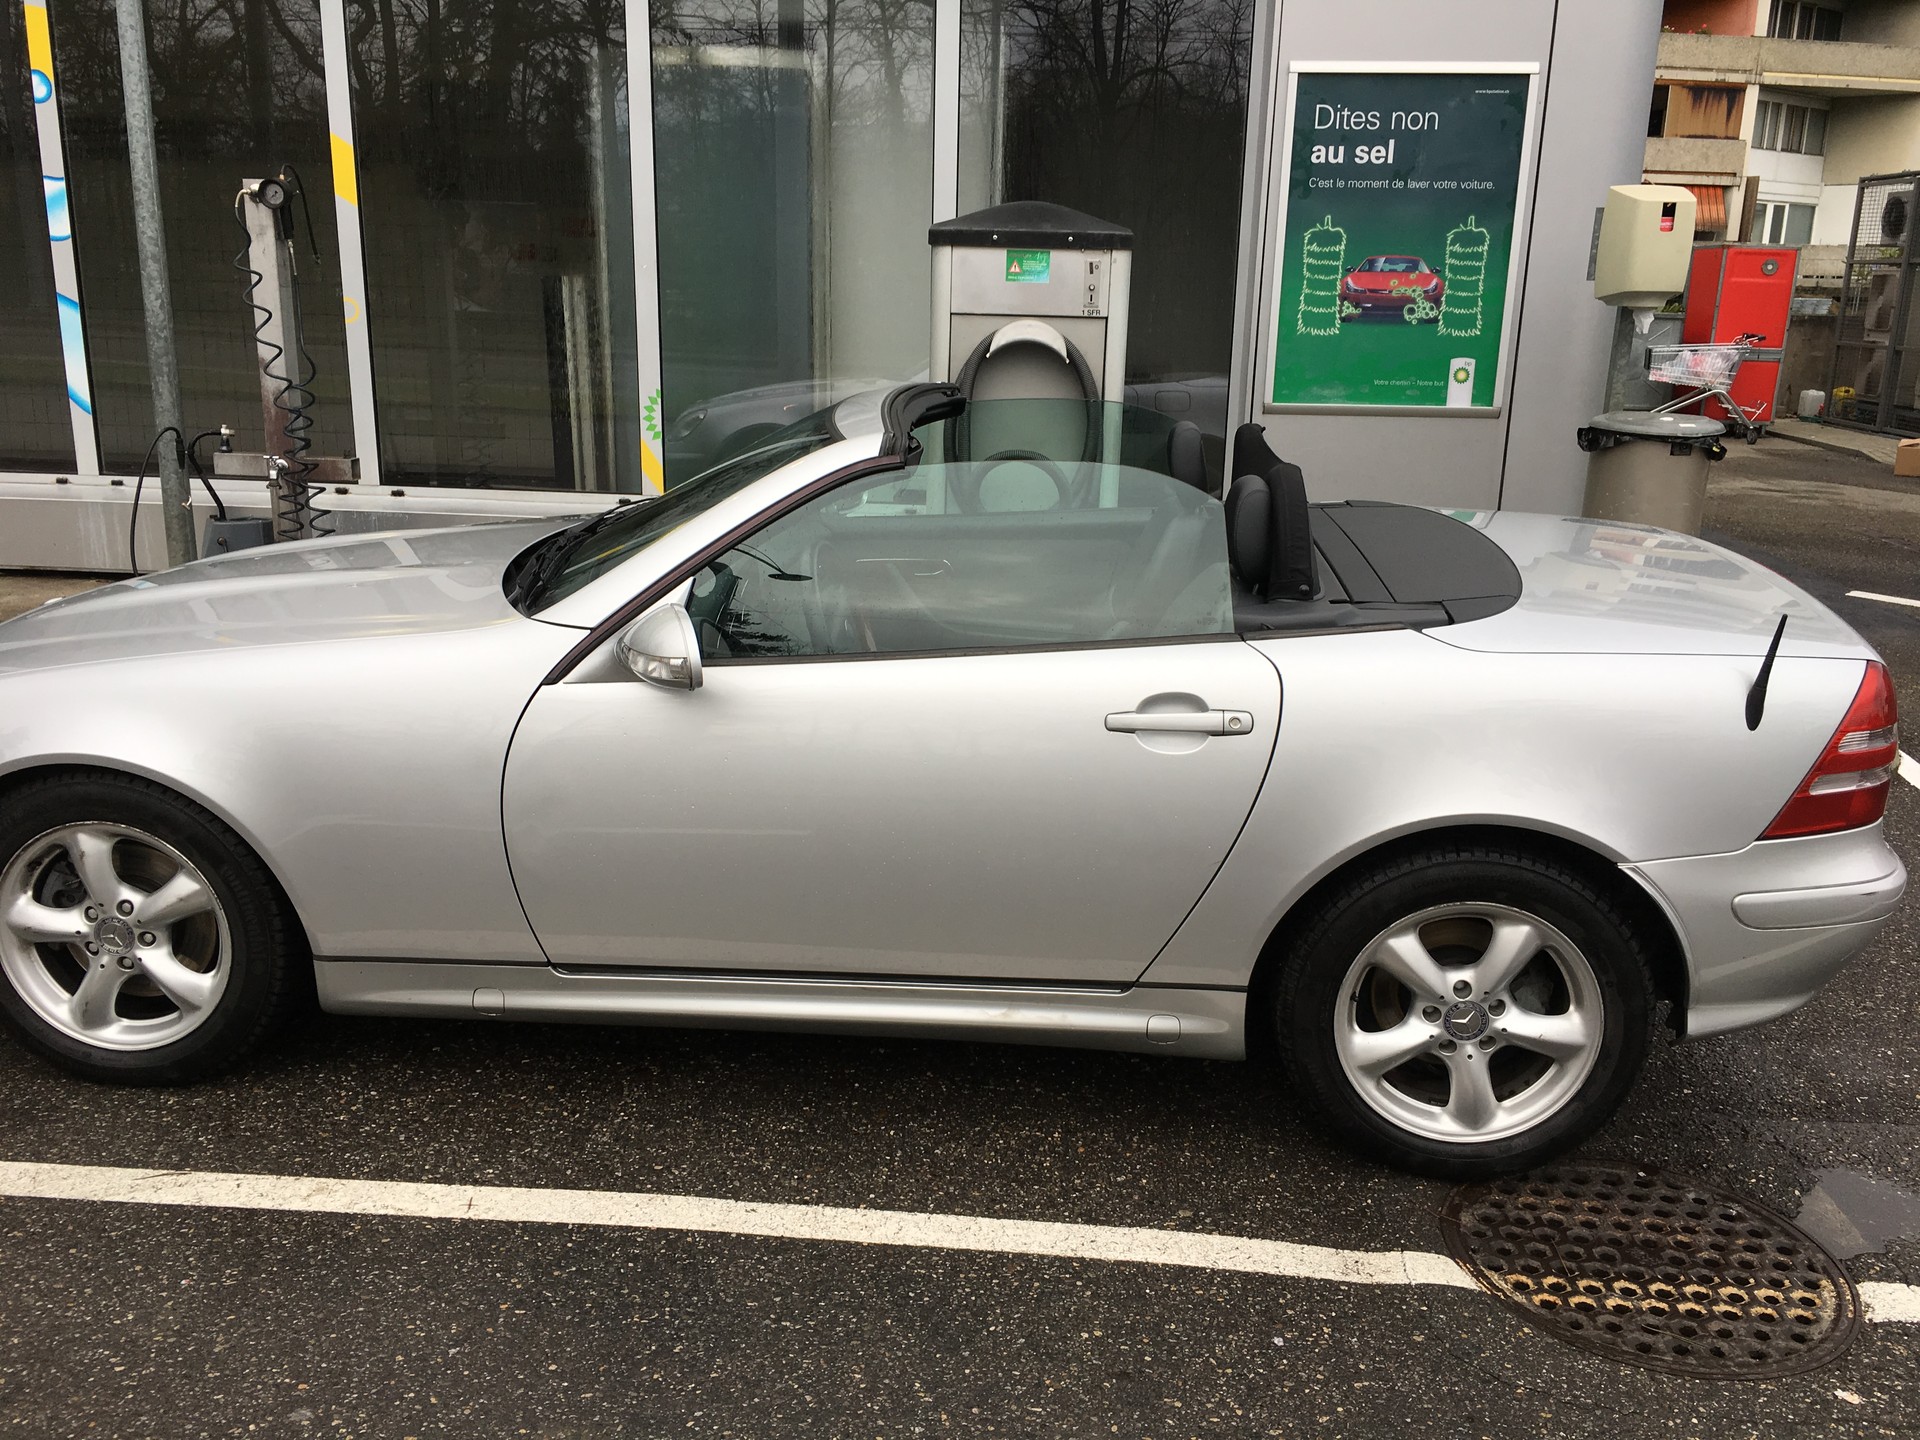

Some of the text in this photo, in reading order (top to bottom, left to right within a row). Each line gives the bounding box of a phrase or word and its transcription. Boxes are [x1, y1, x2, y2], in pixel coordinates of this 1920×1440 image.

[1314, 104, 1439, 130] Dites non
[1310, 139, 1395, 164] au sel
[1308, 177, 1495, 189] C'est le moment de laver votre voiture.
